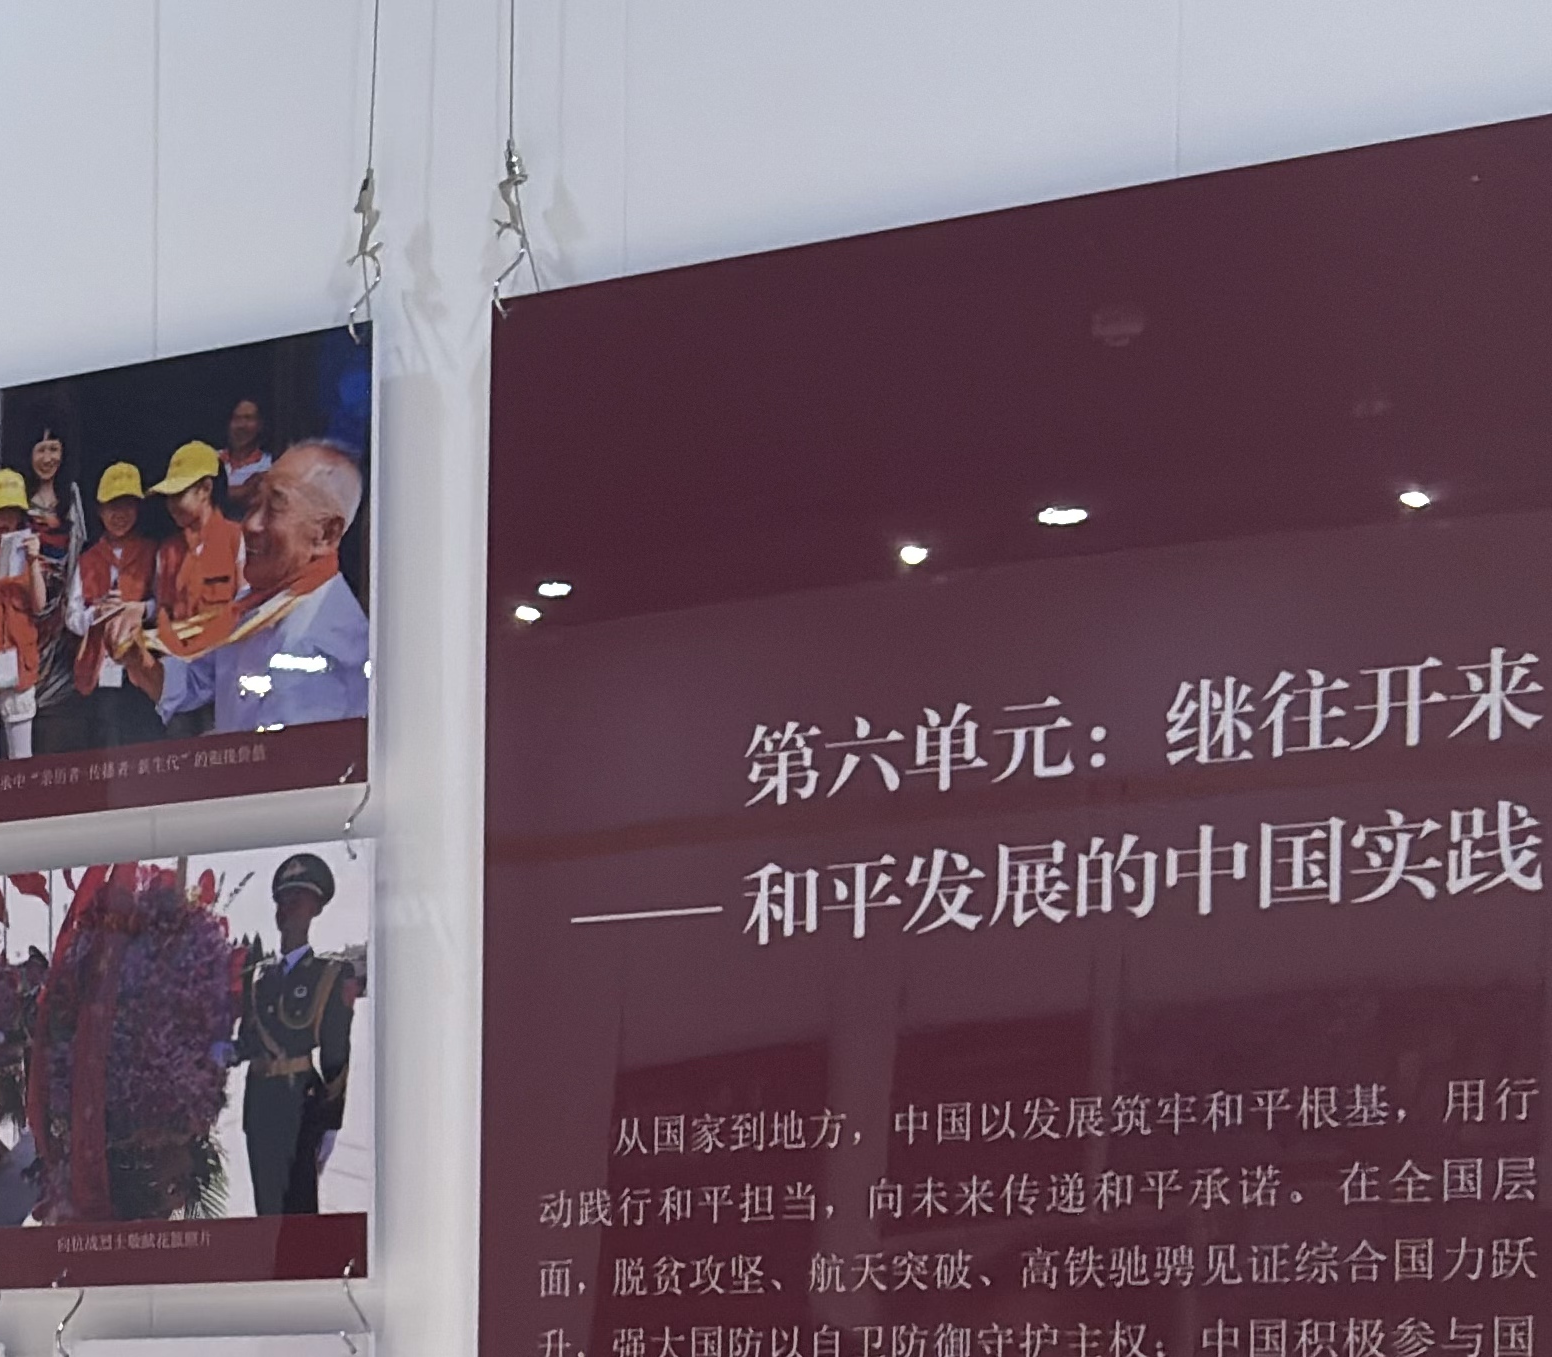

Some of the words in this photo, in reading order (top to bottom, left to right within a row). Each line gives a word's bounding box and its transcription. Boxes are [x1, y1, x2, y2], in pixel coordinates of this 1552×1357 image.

[744, 647, 1545, 807] 第六单元：继往开来
[613, 1078, 1540, 1156] 从国家到地方，中国以发展筑牢和平根基，用行
[539, 1156, 1537, 1228] 动践行和平担当，向未来传递和平承诺。在全国层
[539, 1237, 1538, 1297] 面，脱贫攻坚、航天突破、高铁驰骋见证综合国力跃
